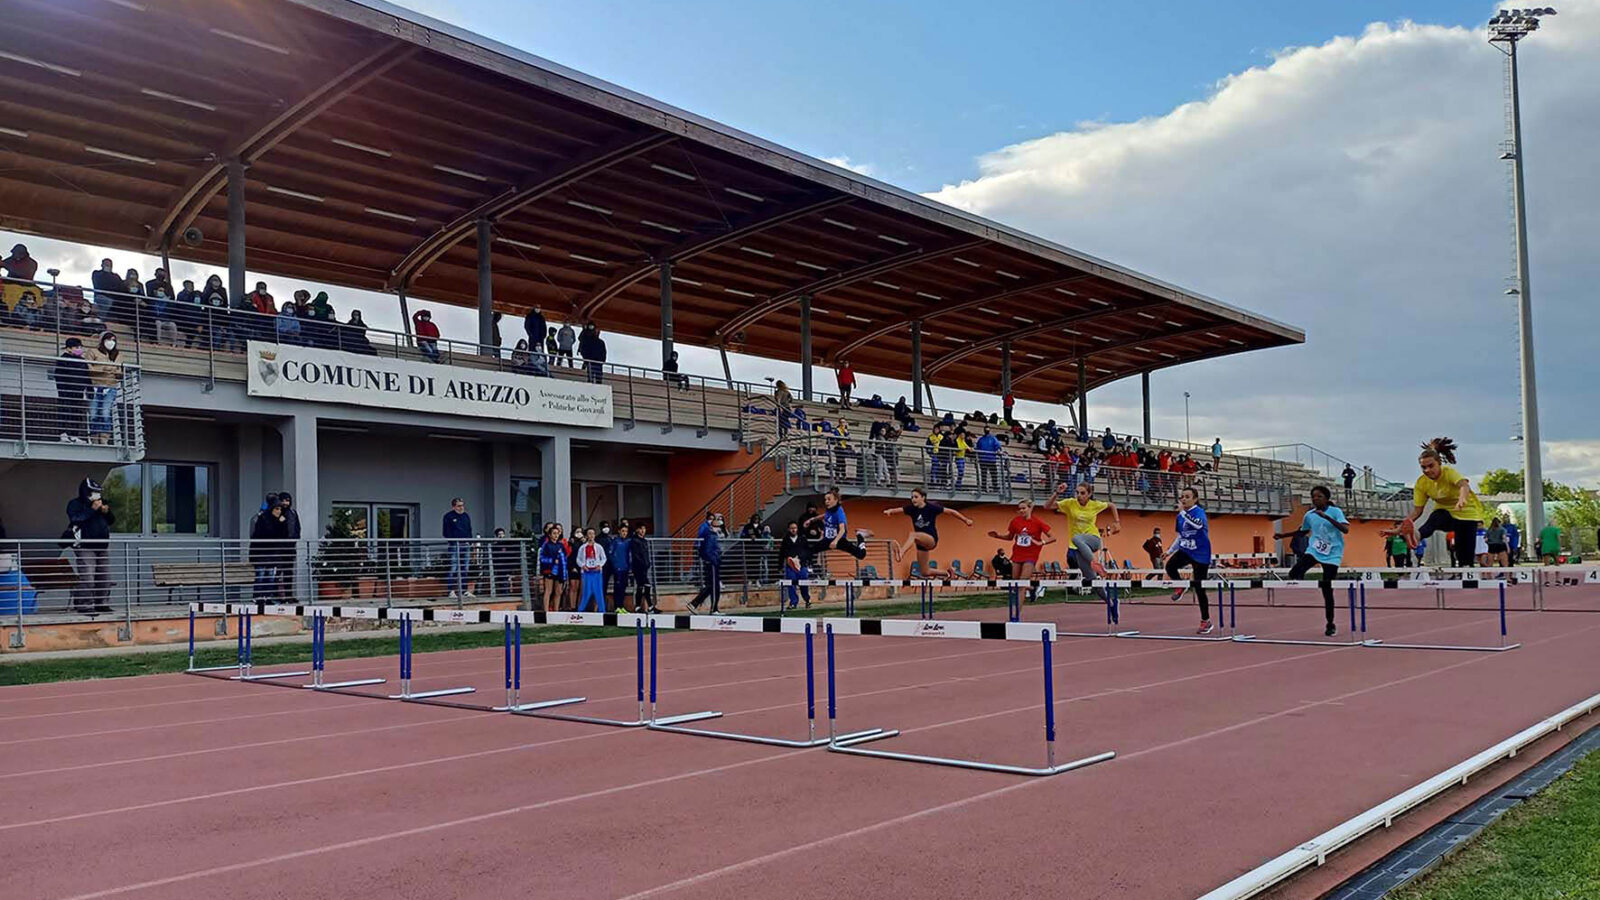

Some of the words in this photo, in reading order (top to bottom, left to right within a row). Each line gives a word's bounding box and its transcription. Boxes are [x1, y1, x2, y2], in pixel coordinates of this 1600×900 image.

[282, 360, 400, 392] COMUNE
[408, 374, 436, 396] DI
[444, 379, 531, 406] AREZZO
[1316, 541, 1328, 551] 39
[1366, 572, 1372, 580] 8
[1521, 571, 1528, 580] 5
[1590, 570, 1597, 580] 4
